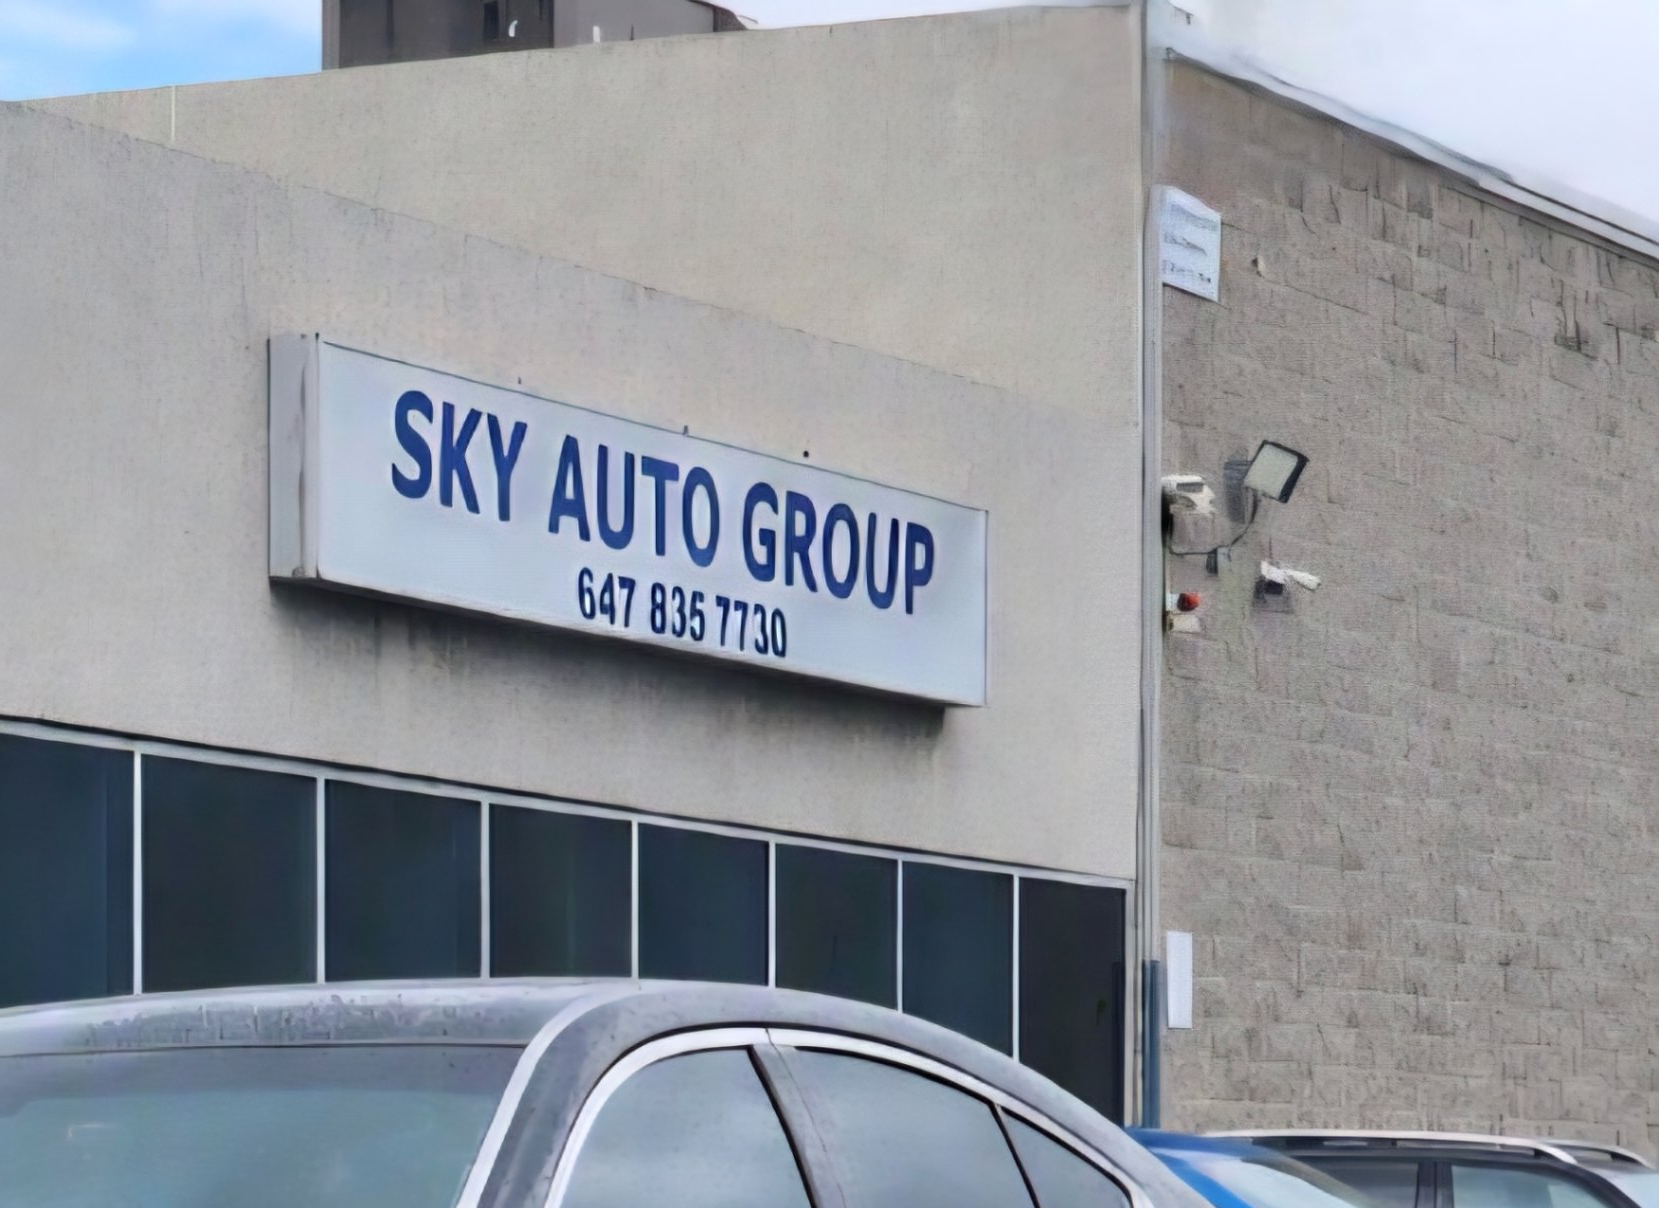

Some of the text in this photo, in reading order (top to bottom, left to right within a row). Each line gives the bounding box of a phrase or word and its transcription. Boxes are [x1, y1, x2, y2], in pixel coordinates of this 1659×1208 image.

[391, 389, 935, 615] SKY AUTO GROUP
[577, 567, 788, 658] 647 835 7730
